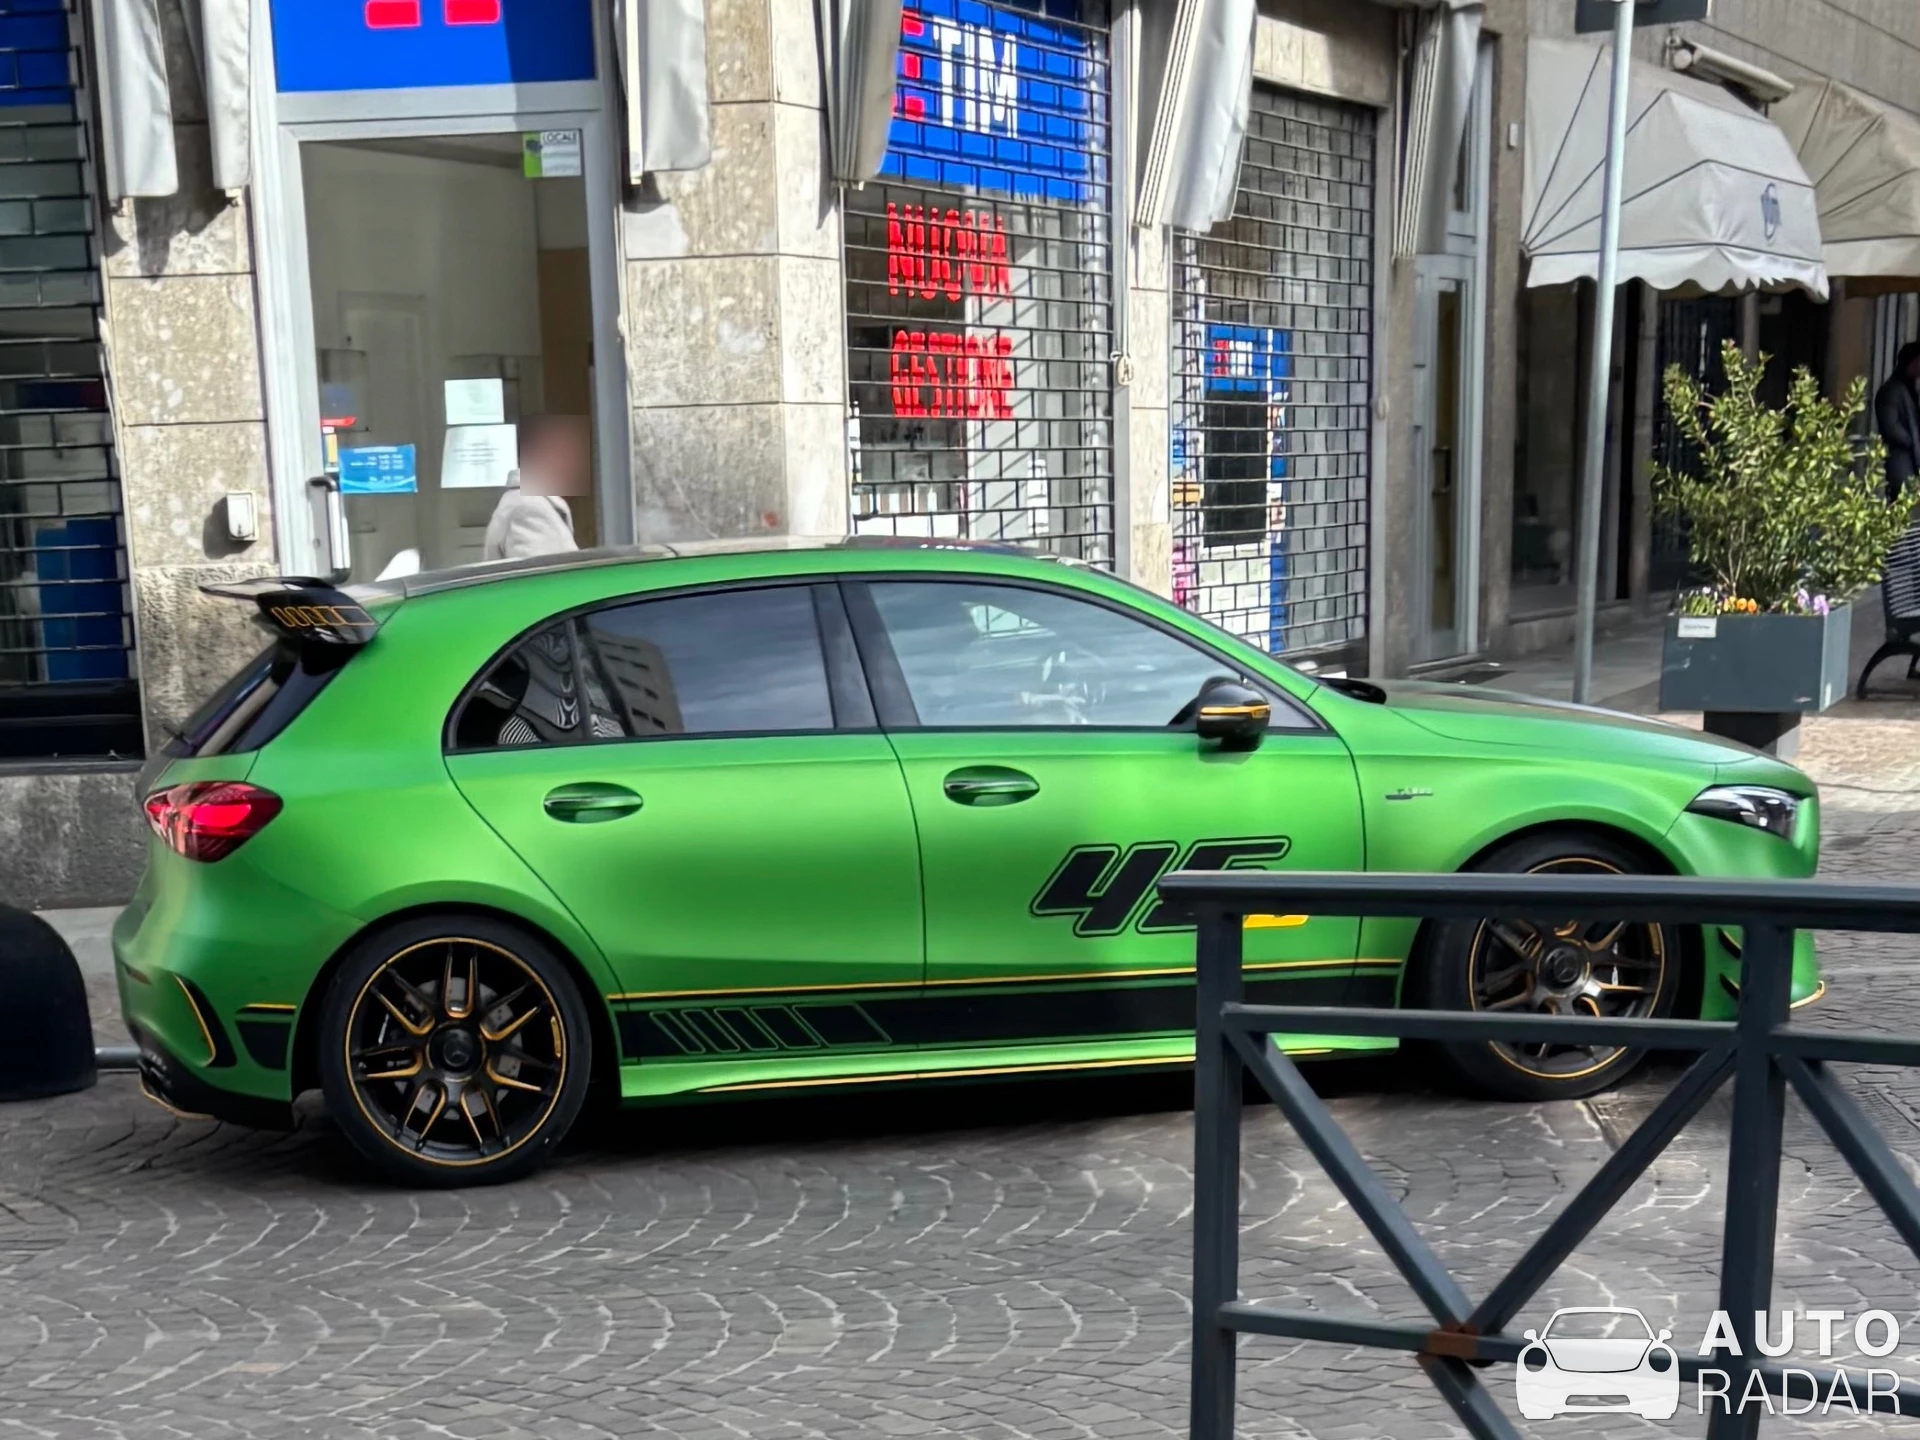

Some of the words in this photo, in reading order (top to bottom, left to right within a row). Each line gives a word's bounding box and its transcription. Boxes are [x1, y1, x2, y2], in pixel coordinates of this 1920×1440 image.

[932, 15, 1018, 139] TIM
[888, 202, 1012, 302] NUOVA
[891, 329, 1013, 419] GESTIONE
